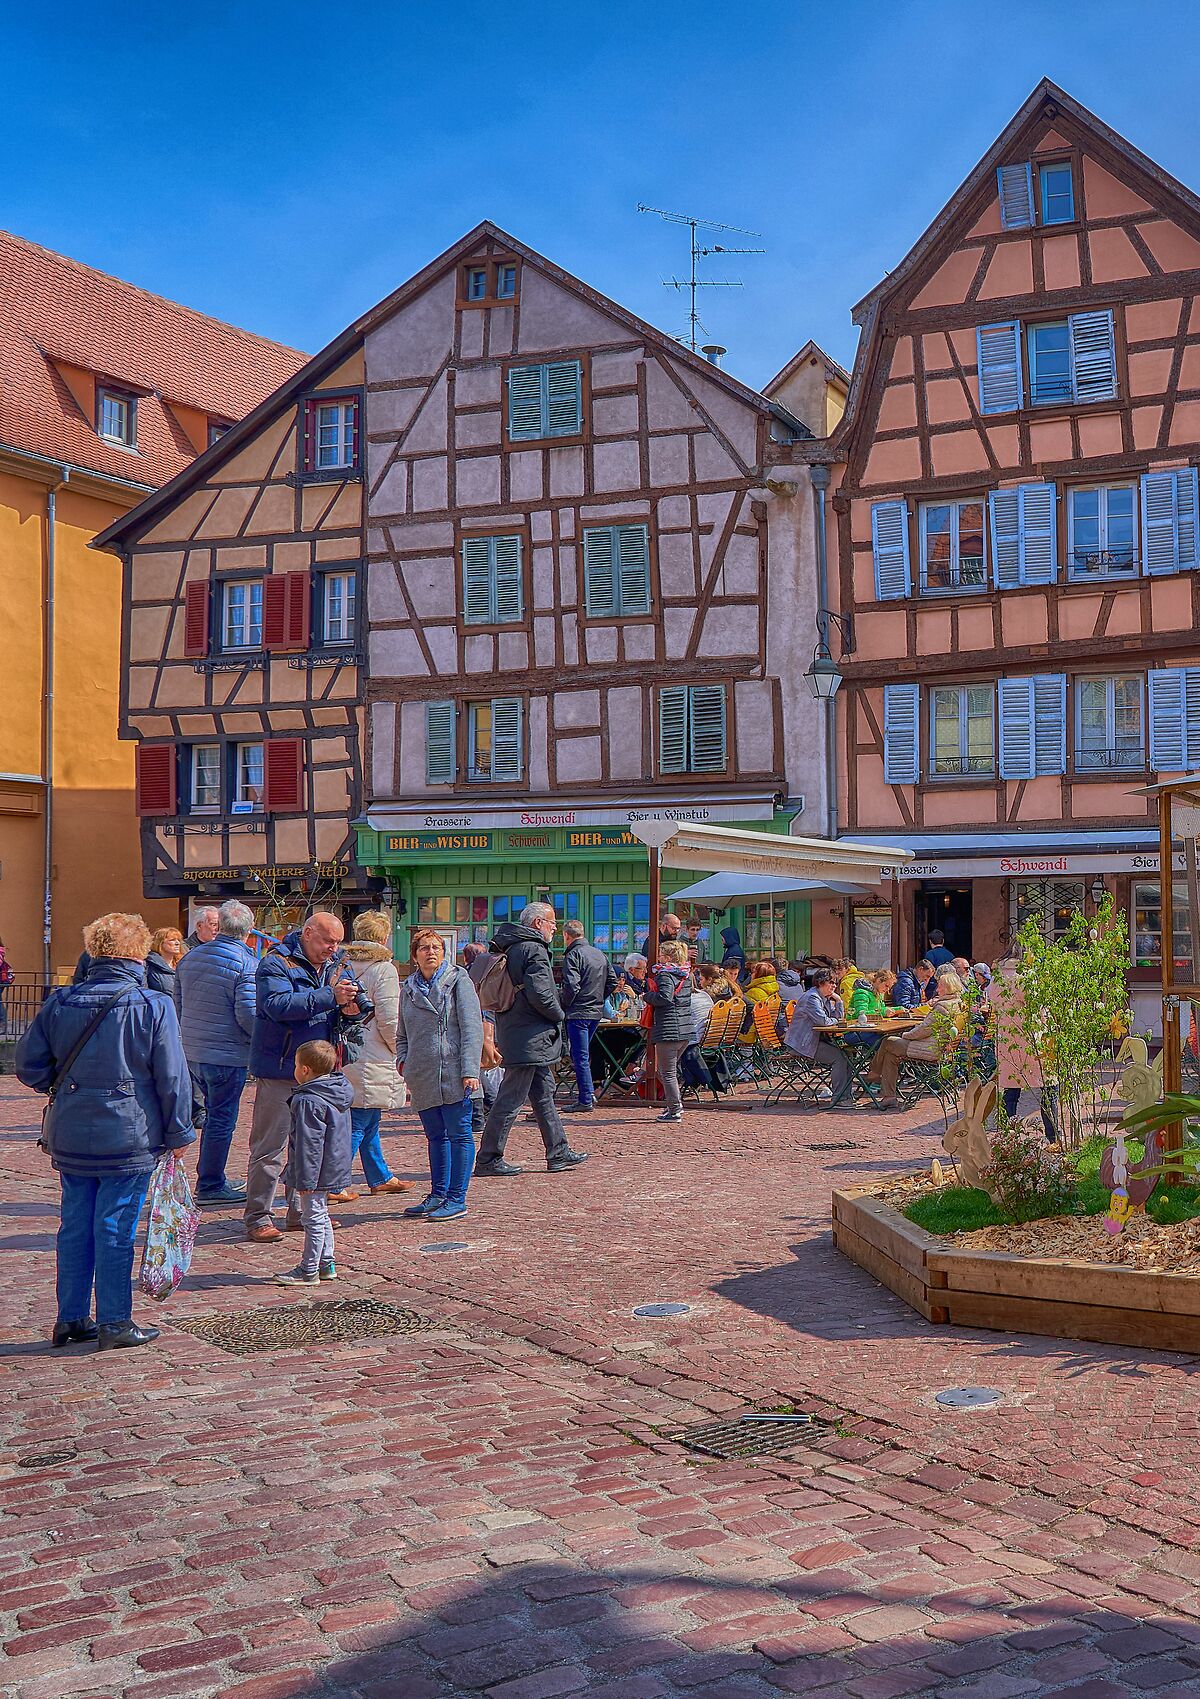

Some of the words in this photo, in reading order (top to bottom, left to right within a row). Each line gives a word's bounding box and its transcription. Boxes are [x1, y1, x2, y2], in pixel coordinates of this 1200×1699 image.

[521, 812, 575, 826] Schwendi
[626, 811, 649, 821] Bier
[665, 808, 709, 820] Winstub
[424, 816, 472, 827] Brasserie
[437, 836, 488, 849] WISTUB
[508, 833, 551, 848] Schwendi
[1000, 857, 1067, 874] Schwendi
[1130, 856, 1159, 868] Bier
[183, 868, 239, 881] BIJOUTERIE
[318, 865, 349, 878] HELD
[881, 863, 938, 876] Bsserie
